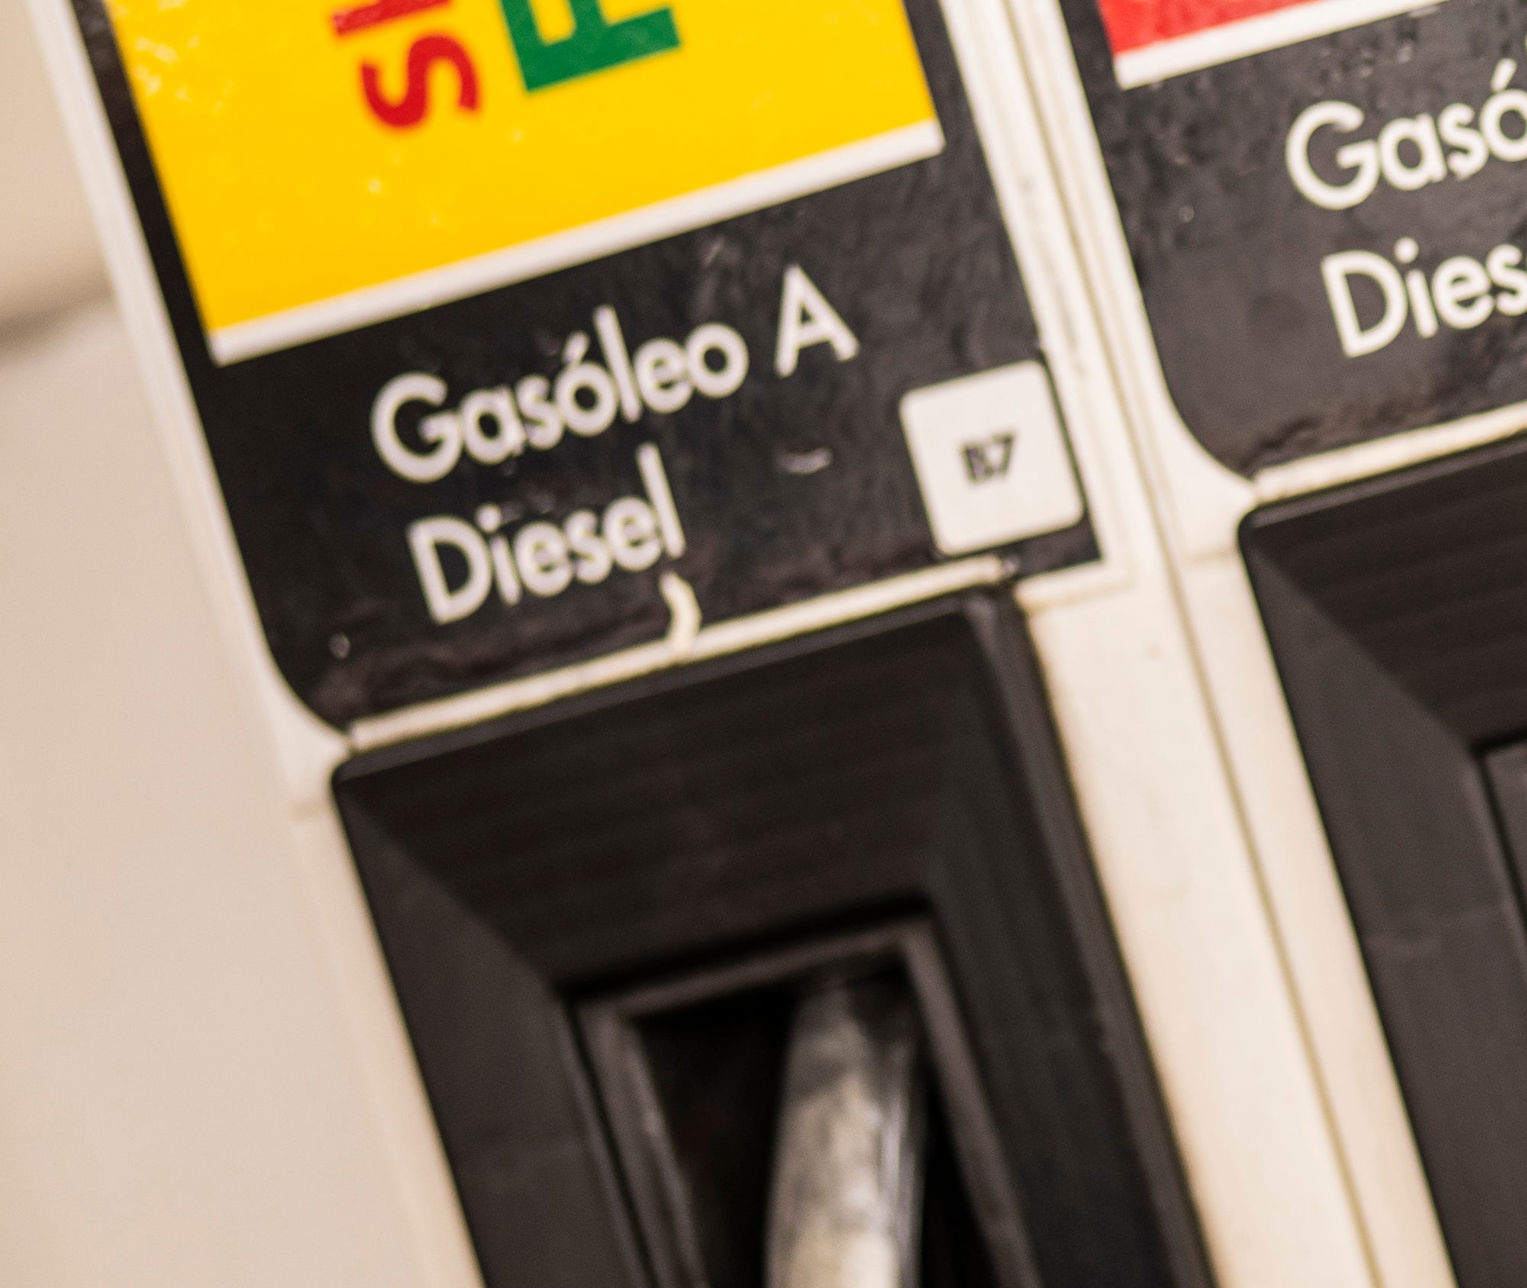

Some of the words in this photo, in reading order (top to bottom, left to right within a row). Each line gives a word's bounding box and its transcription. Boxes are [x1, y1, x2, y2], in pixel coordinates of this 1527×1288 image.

[372, 305, 748, 483] Gasóleo
[776, 265, 858, 376] A
[409, 442, 686, 625] Diesel
